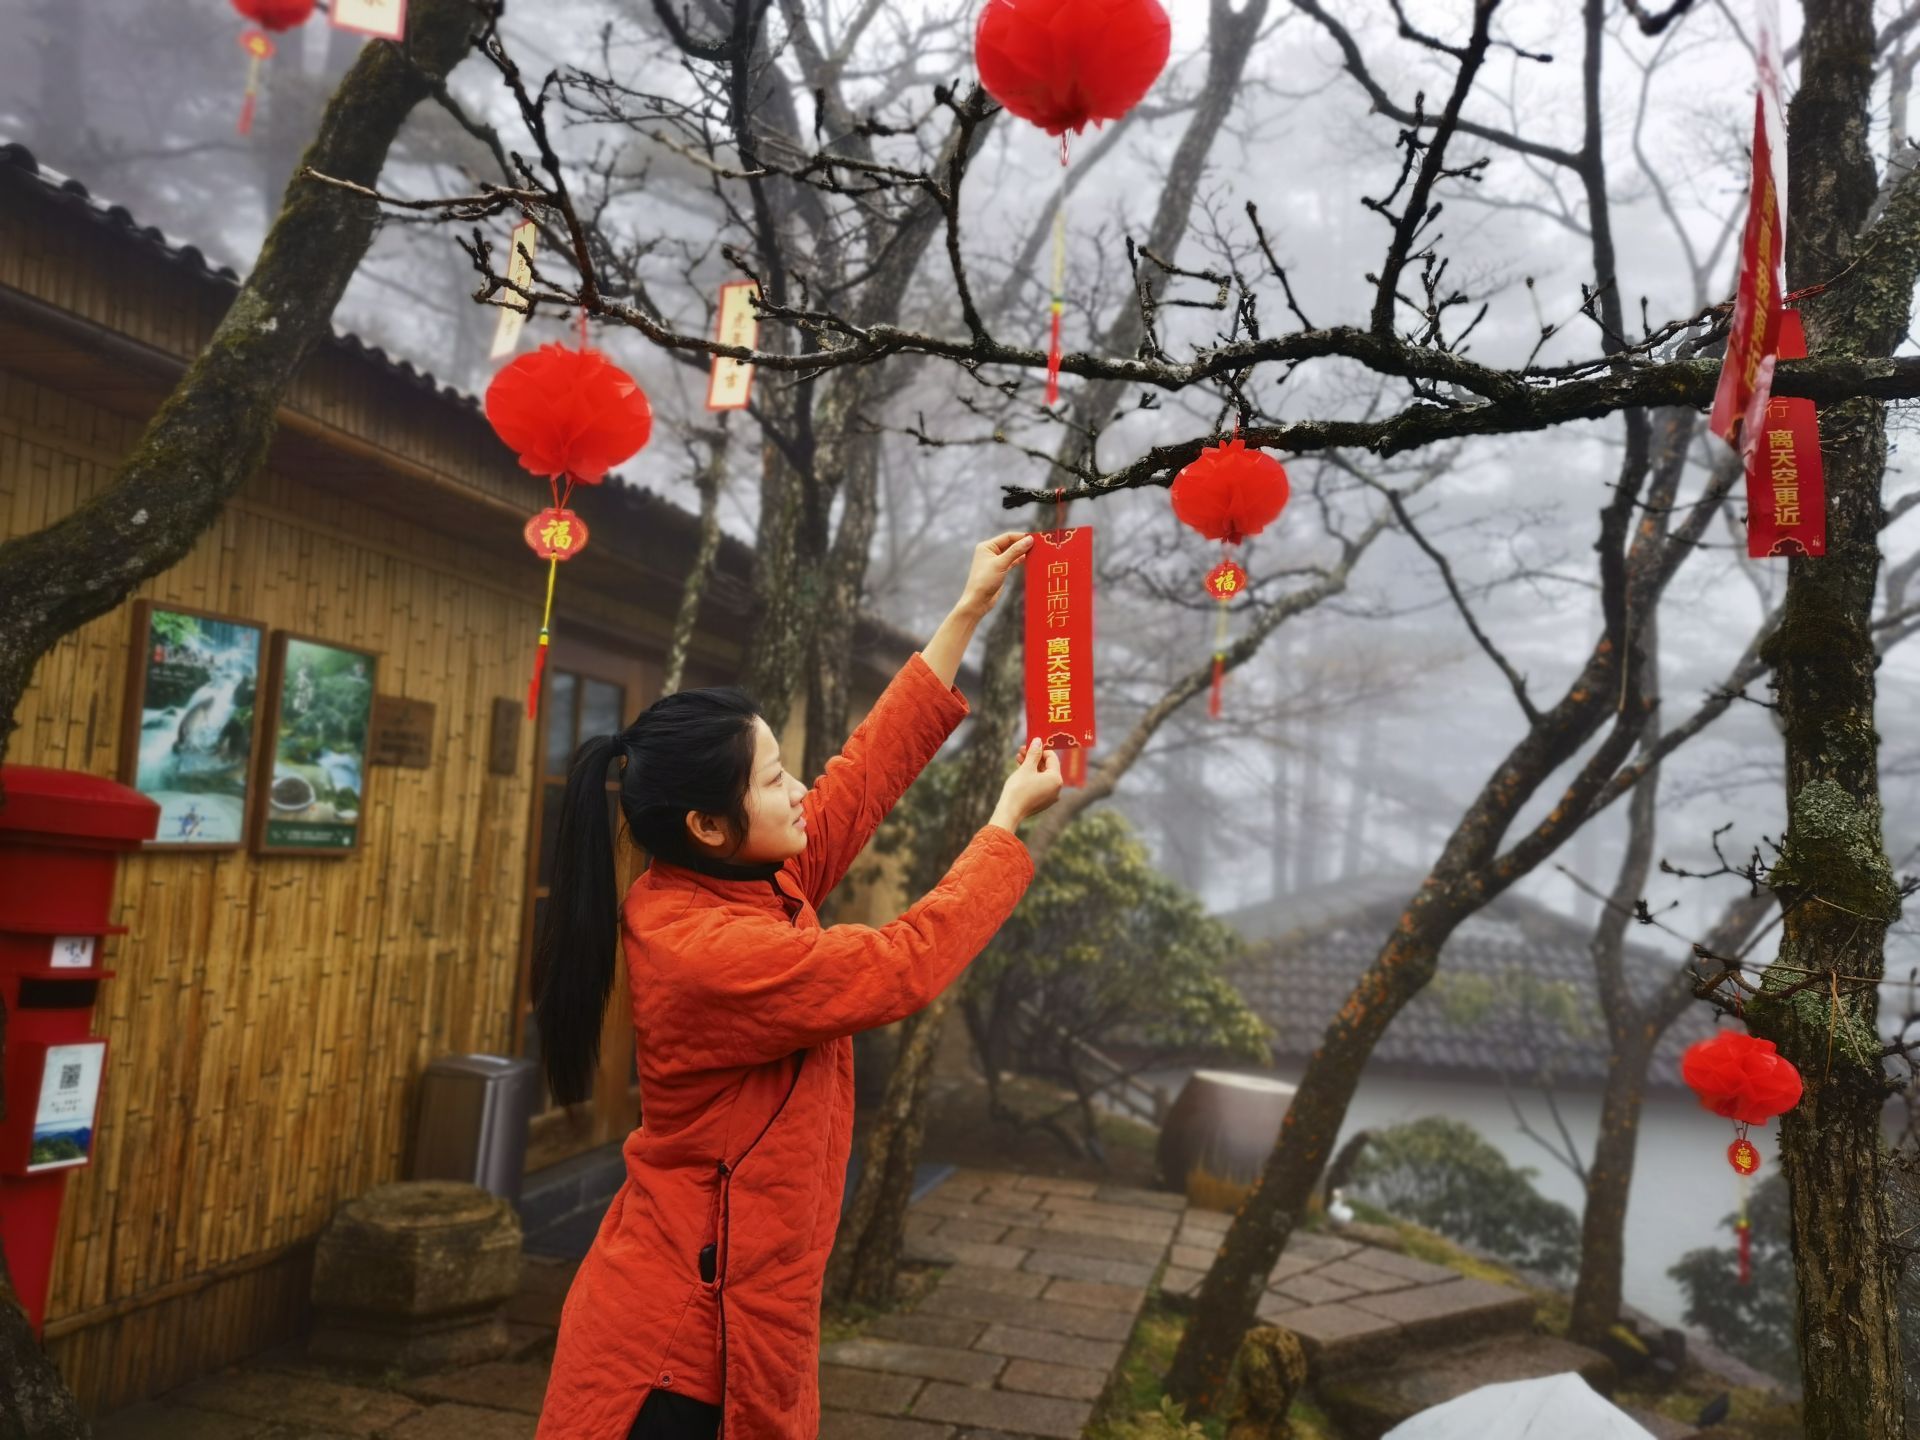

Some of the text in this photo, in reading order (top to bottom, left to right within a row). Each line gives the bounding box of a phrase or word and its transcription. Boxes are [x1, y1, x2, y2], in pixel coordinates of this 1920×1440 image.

[1767, 429, 1801, 526] 离天空更近
[541, 519, 573, 550] 福
[1214, 569, 1236, 592] 福
[1046, 561, 1072, 723] 向山而行 离天空更近
